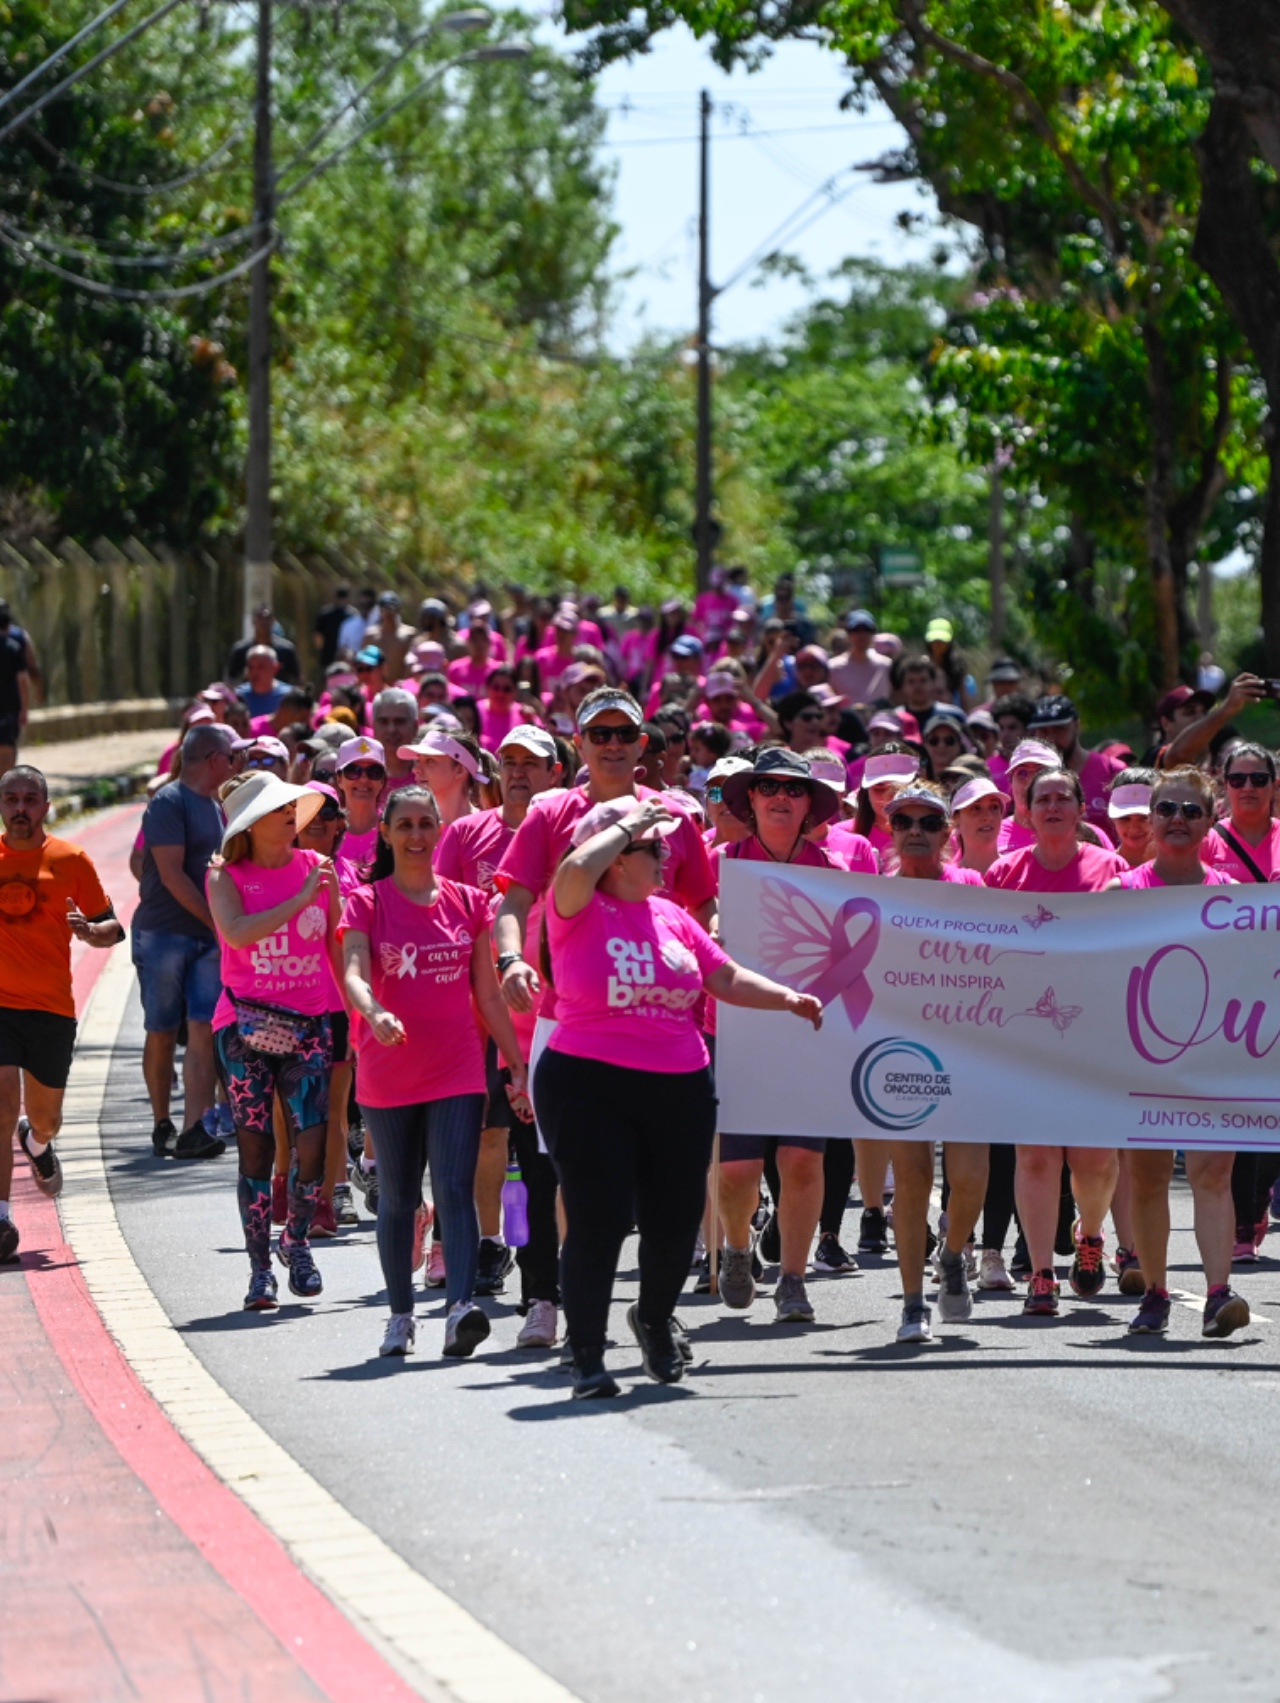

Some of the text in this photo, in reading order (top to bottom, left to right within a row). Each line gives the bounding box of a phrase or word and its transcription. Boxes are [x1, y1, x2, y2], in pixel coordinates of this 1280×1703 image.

[890, 914, 1019, 935] QUEM PROCURA
[606, 937, 654, 962] ou
[918, 939, 1045, 966] cura
[435, 964, 464, 984] cuid
[614, 958, 656, 985] tu
[883, 970, 1006, 991] QUEM INSPIRA
[921, 989, 1030, 1029] cuida
[884, 1072, 952, 1085] CENTRO DE
[883, 1084, 953, 1097] ONCOLOGIA
[1138, 1109, 1216, 1130] JUNTOS,
